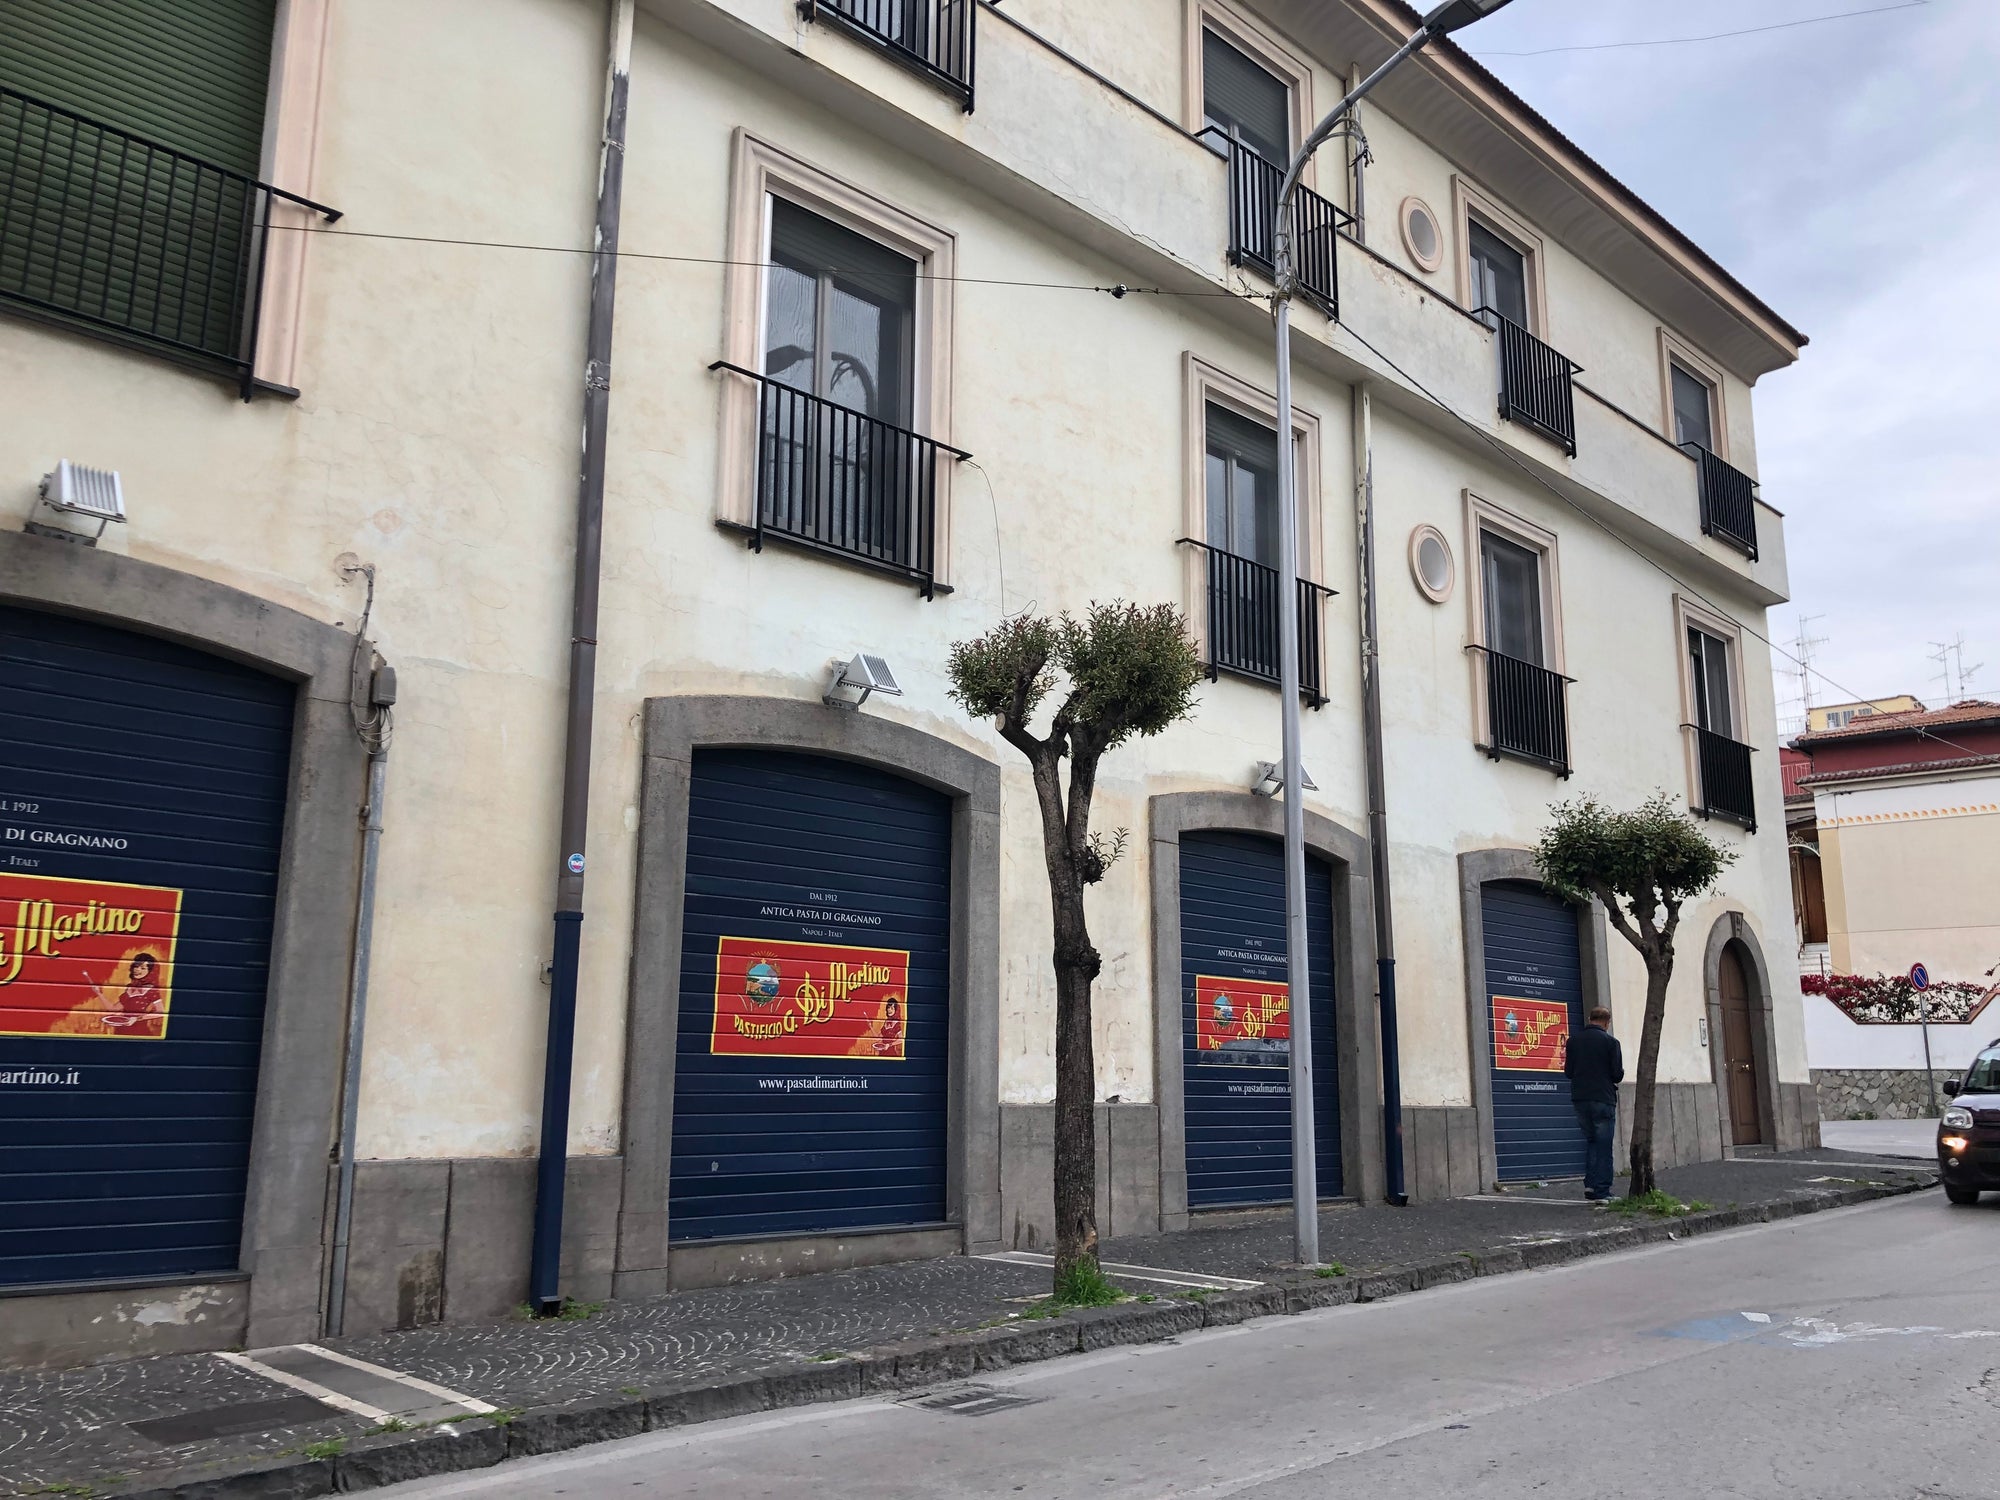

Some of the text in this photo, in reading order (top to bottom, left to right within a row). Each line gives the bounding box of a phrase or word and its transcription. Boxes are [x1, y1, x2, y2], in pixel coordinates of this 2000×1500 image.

[13, 802, 40, 814] 1912
[5, 828, 128, 850] DI GRAGNANO
[809, 892, 838, 902] DAL 1912
[760, 906, 882, 926] ANTICA PASTA DI GRAGNANO
[0, 898, 145, 985] Martino
[1217, 949, 1237, 958] ANTICA
[1238, 951, 1253, 960] PASTA
[1253, 953, 1260, 961] DI
[734, 1014, 783, 1041] PASTIFICIO
[795, 970, 827, 1025] Di
[820, 961, 892, 1023] Martino
[0, 1067, 81, 1085] artino.it
[758, 1075, 868, 1093] www.pastadimartino.it
